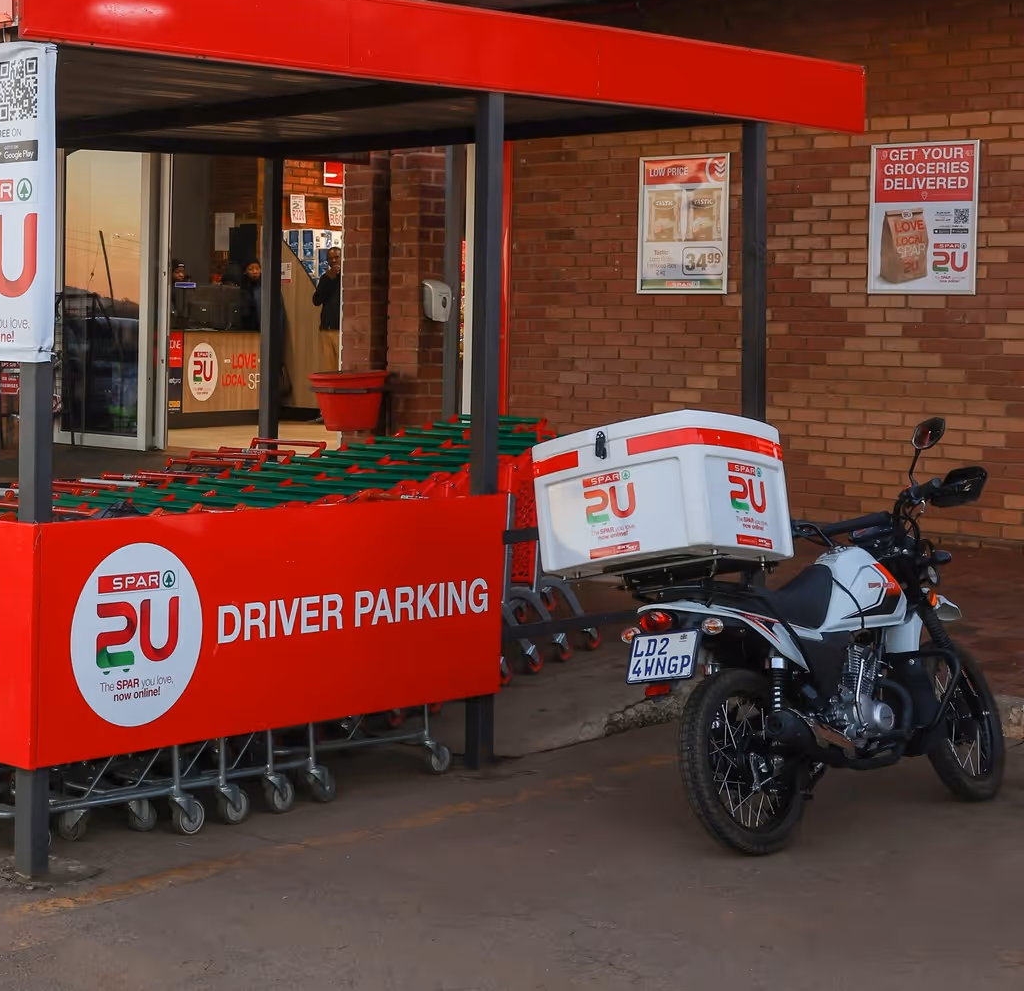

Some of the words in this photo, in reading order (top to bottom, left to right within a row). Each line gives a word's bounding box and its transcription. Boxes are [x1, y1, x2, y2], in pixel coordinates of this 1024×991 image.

[11, 128, 22, 137] ON
[3, 151, 22, 160] Google
[22, 150, 35, 159] Play
[889, 149, 918, 161] GET
[922, 147, 964, 160] YOUR
[649, 168, 665, 177] LOW
[667, 167, 689, 176] PRICE
[884, 162, 970, 176] GROCERIES
[883, 176, 969, 191] DELIVERED
[894, 220, 925, 233] LOVE
[933, 251, 968, 272] 2U
[232, 353, 257, 369] LOVE
[193, 361, 213, 382] 2U
[221, 374, 246, 387] LOCAL
[734, 464, 756, 474] SPAR
[591, 473, 619, 486] SPAR
[728, 475, 766, 513] 2U
[584, 482, 636, 524] 2U
[600, 526, 614, 535] SPAR
[112, 573, 159, 590] SPAR
[217, 593, 343, 645] DRIVER
[353, 577, 490, 628] PARKING
[96, 596, 179, 669] 2U
[633, 637, 670, 658] LD2
[632, 654, 691, 677] 4WNGP
[100, 682, 115, 693] The
[116, 678, 140, 691] SPAR
[141, 678, 156, 690] you
[156, 675, 174, 688] love,
[113, 691, 132, 702] now
[133, 686, 161, 699] online!
